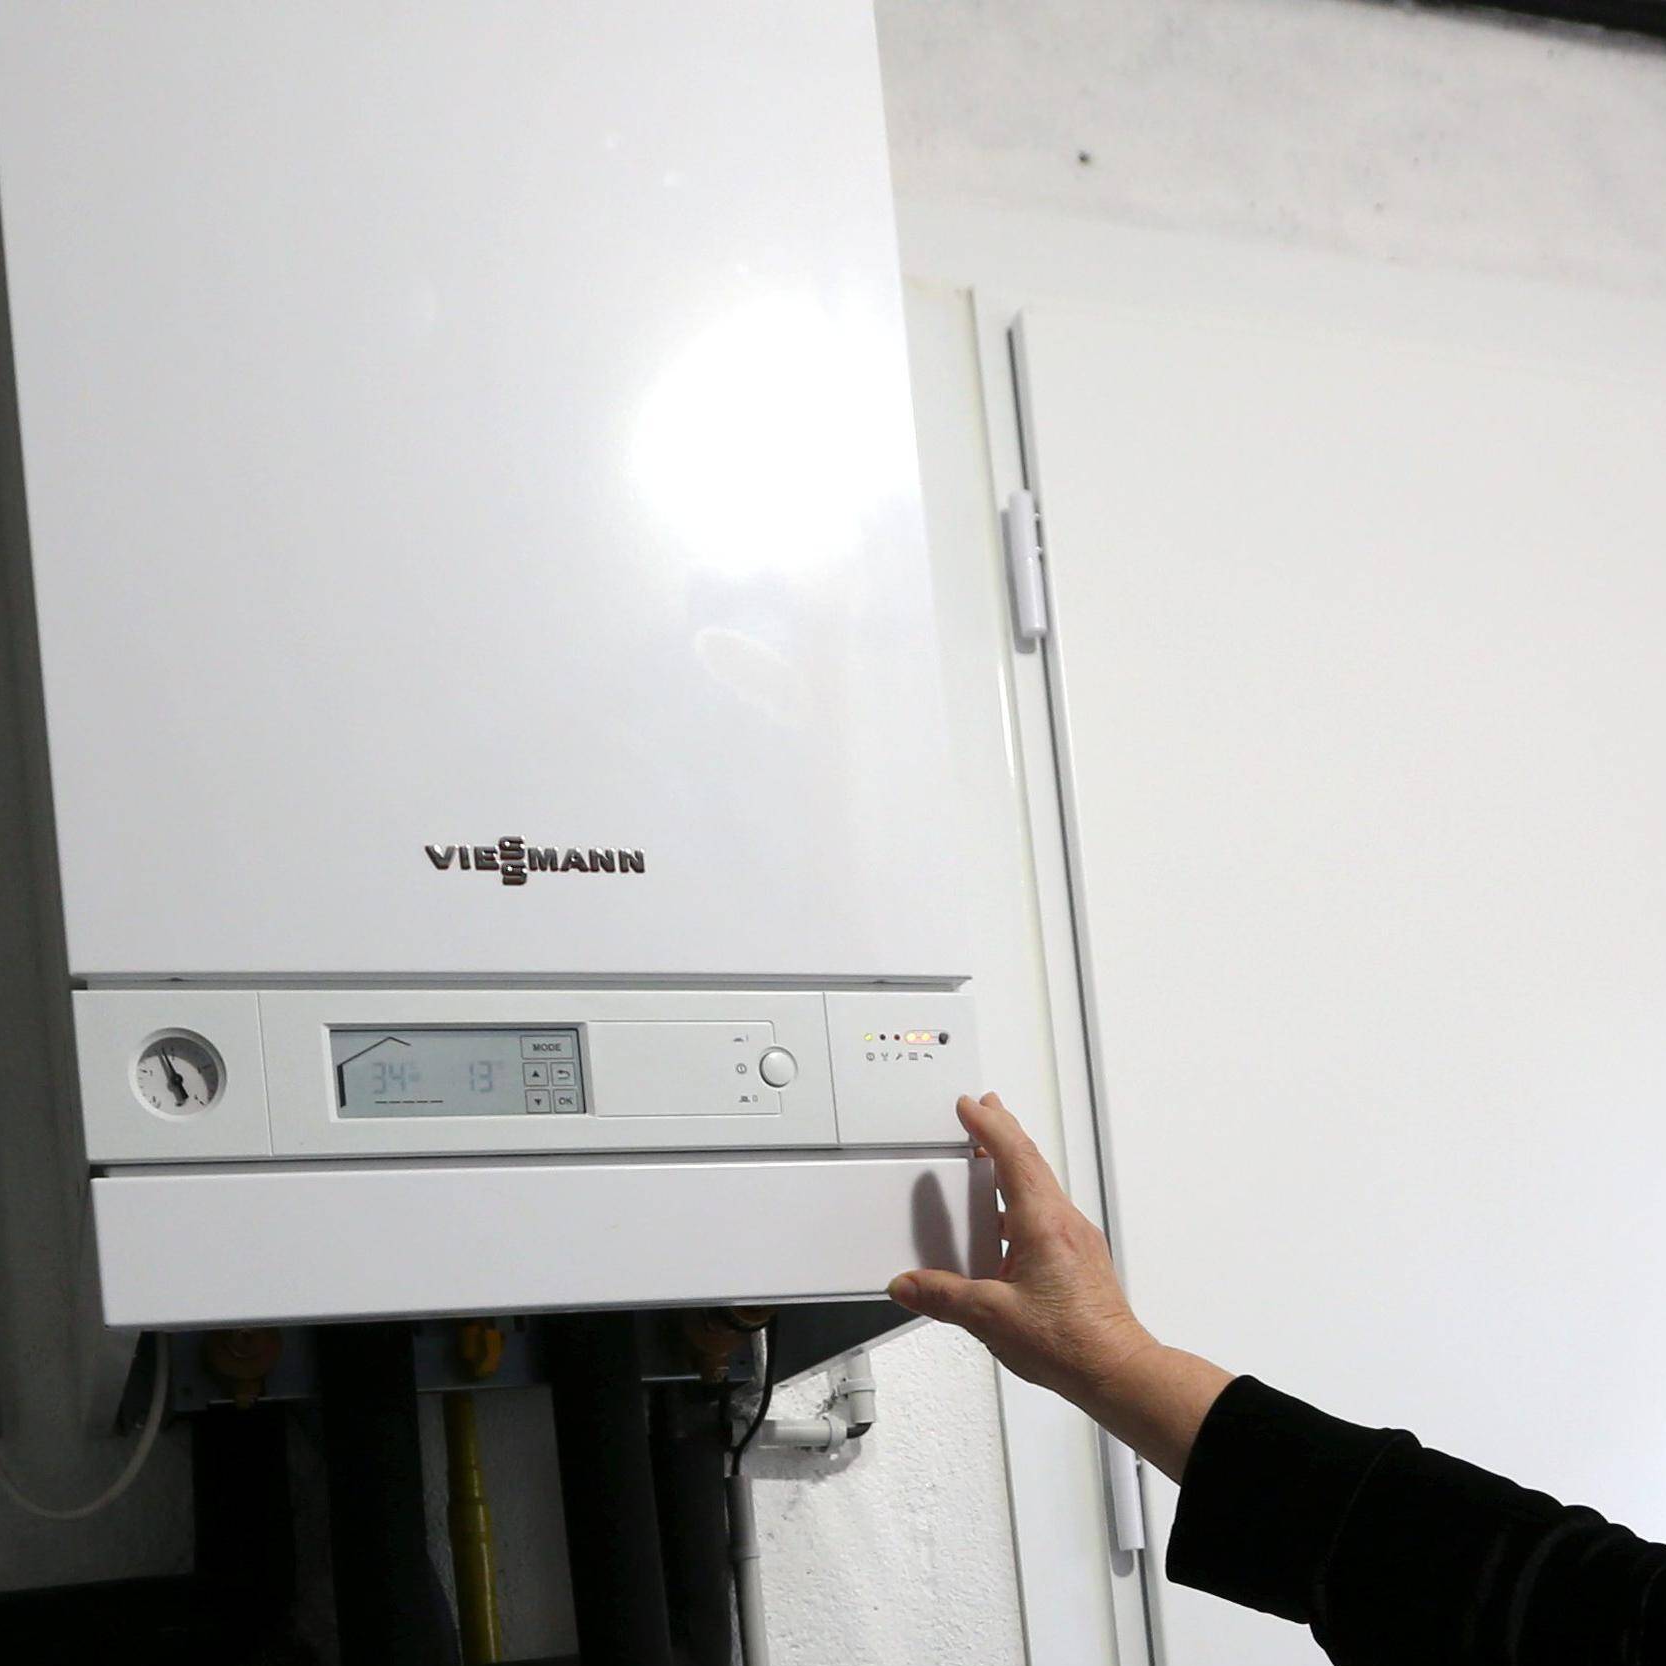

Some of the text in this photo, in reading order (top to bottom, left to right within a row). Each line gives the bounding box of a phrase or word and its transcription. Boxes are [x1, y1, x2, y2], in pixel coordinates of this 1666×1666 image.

[425, 836, 645, 886] VIESSMANN
[533, 1043, 561, 1052] MODE
[558, 1097, 573, 1106] OK
